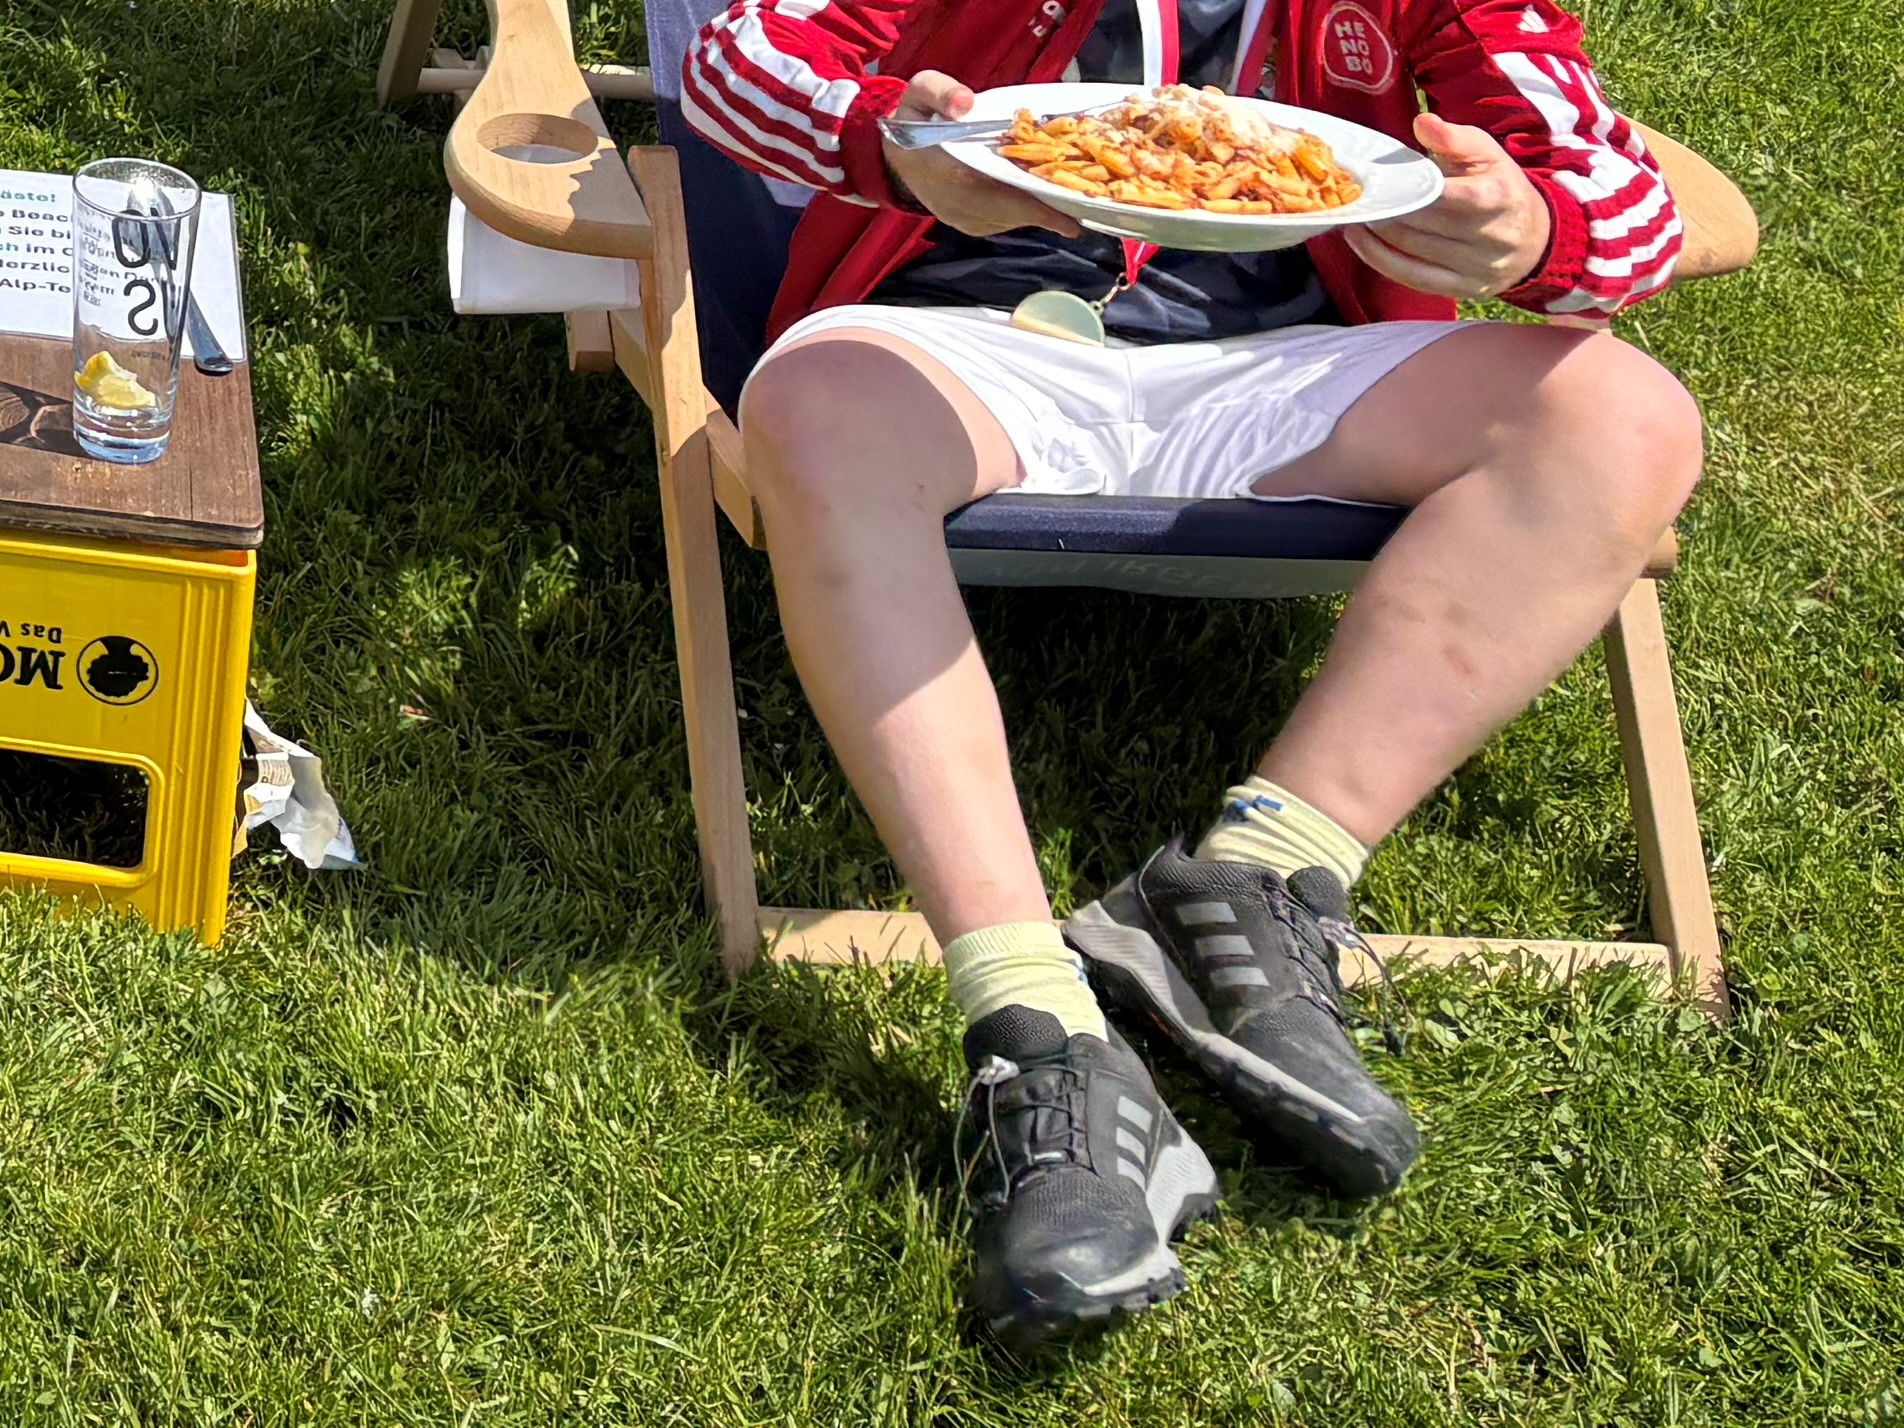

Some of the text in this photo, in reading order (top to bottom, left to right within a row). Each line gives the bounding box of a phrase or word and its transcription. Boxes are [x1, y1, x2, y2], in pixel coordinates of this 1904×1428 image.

[12, 209, 73, 223] Beac
[9, 225, 44, 237] Sie
[51, 228, 72, 240] bi
[26, 243, 55, 255] im
[20, 622, 63, 644] Das
